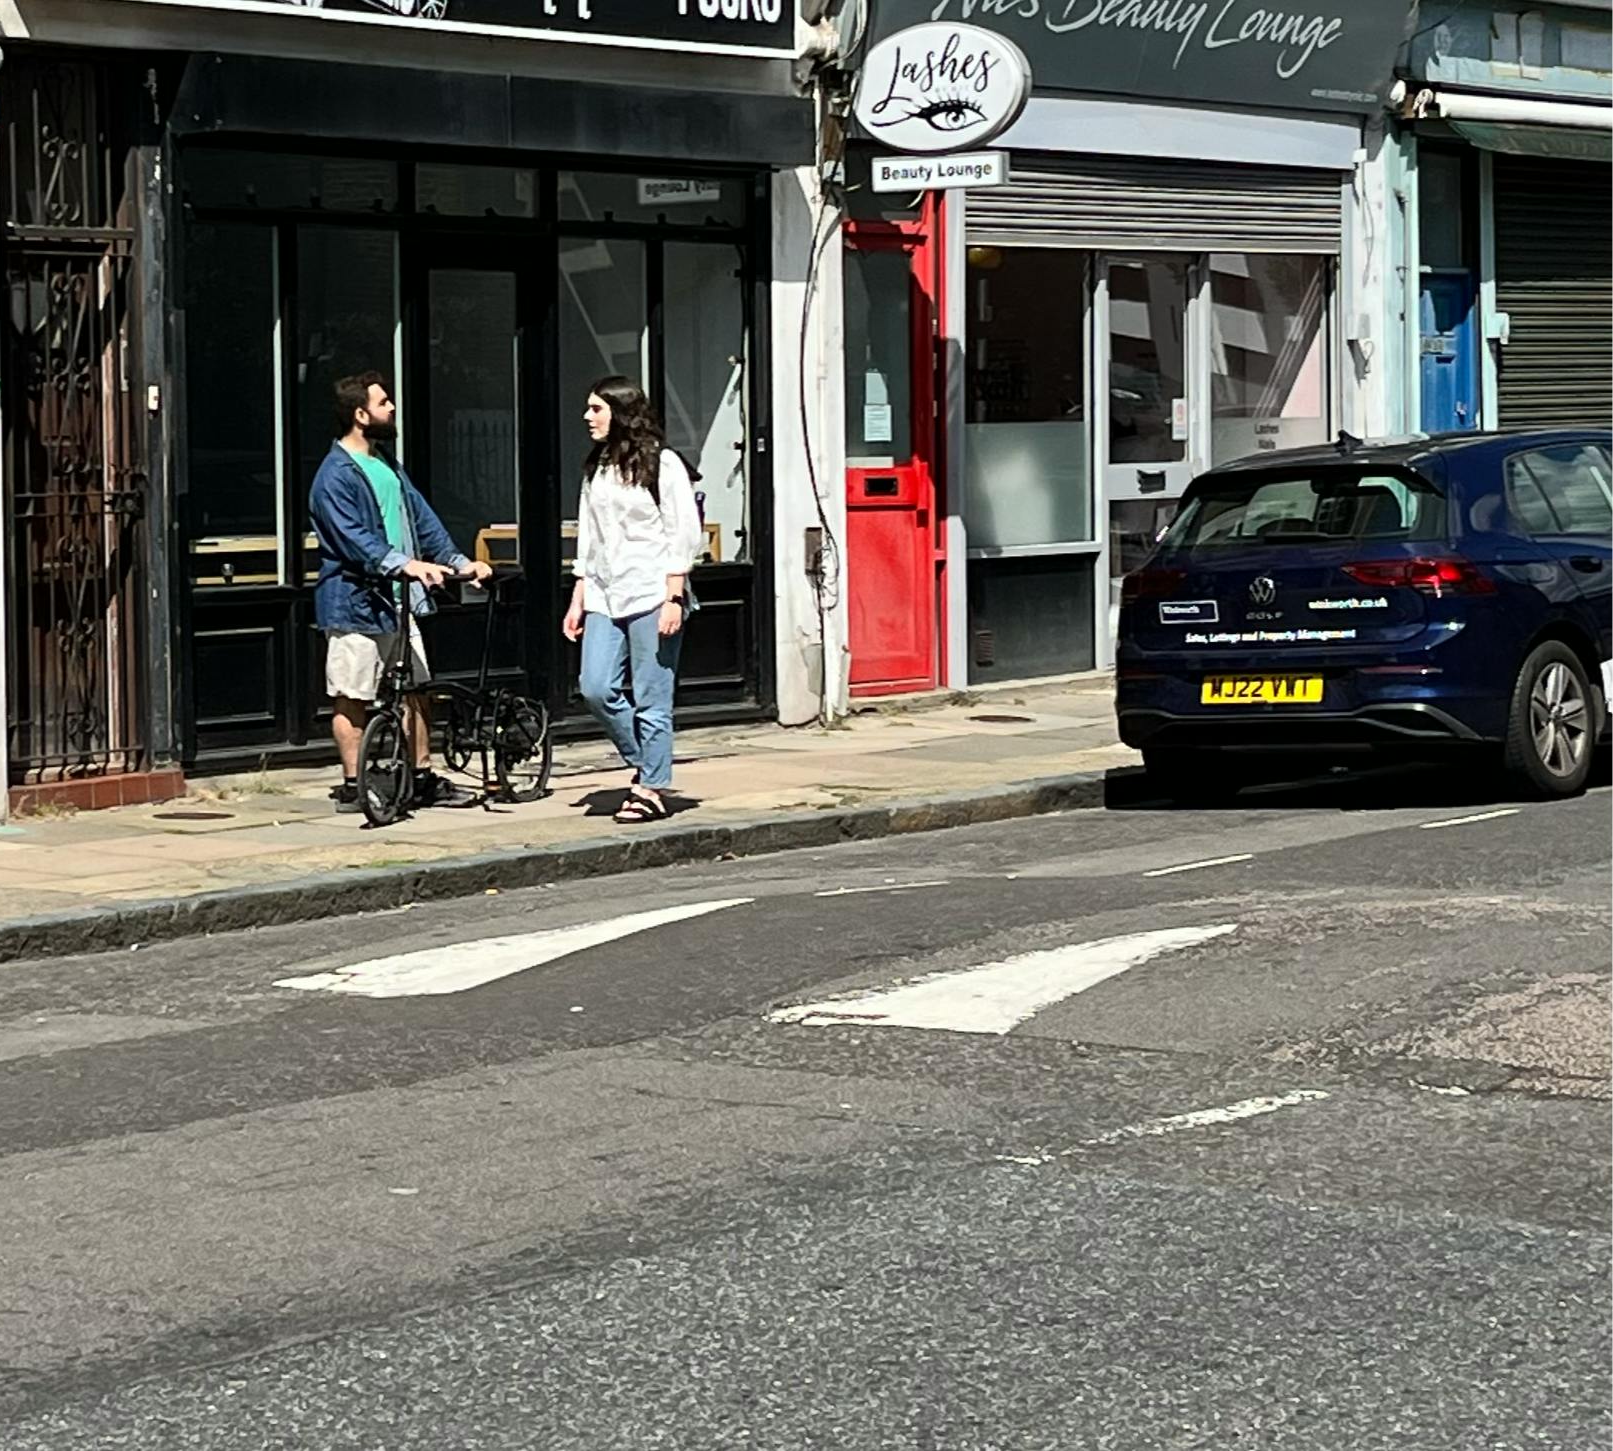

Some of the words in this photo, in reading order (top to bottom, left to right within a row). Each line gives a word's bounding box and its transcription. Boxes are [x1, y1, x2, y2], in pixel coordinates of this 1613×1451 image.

[871, 32, 1001, 114] Lashes
[1204, 0, 1343, 79] Lounge
[881, 165, 933, 182] Beauty
[938, 162, 992, 180] Lounge
